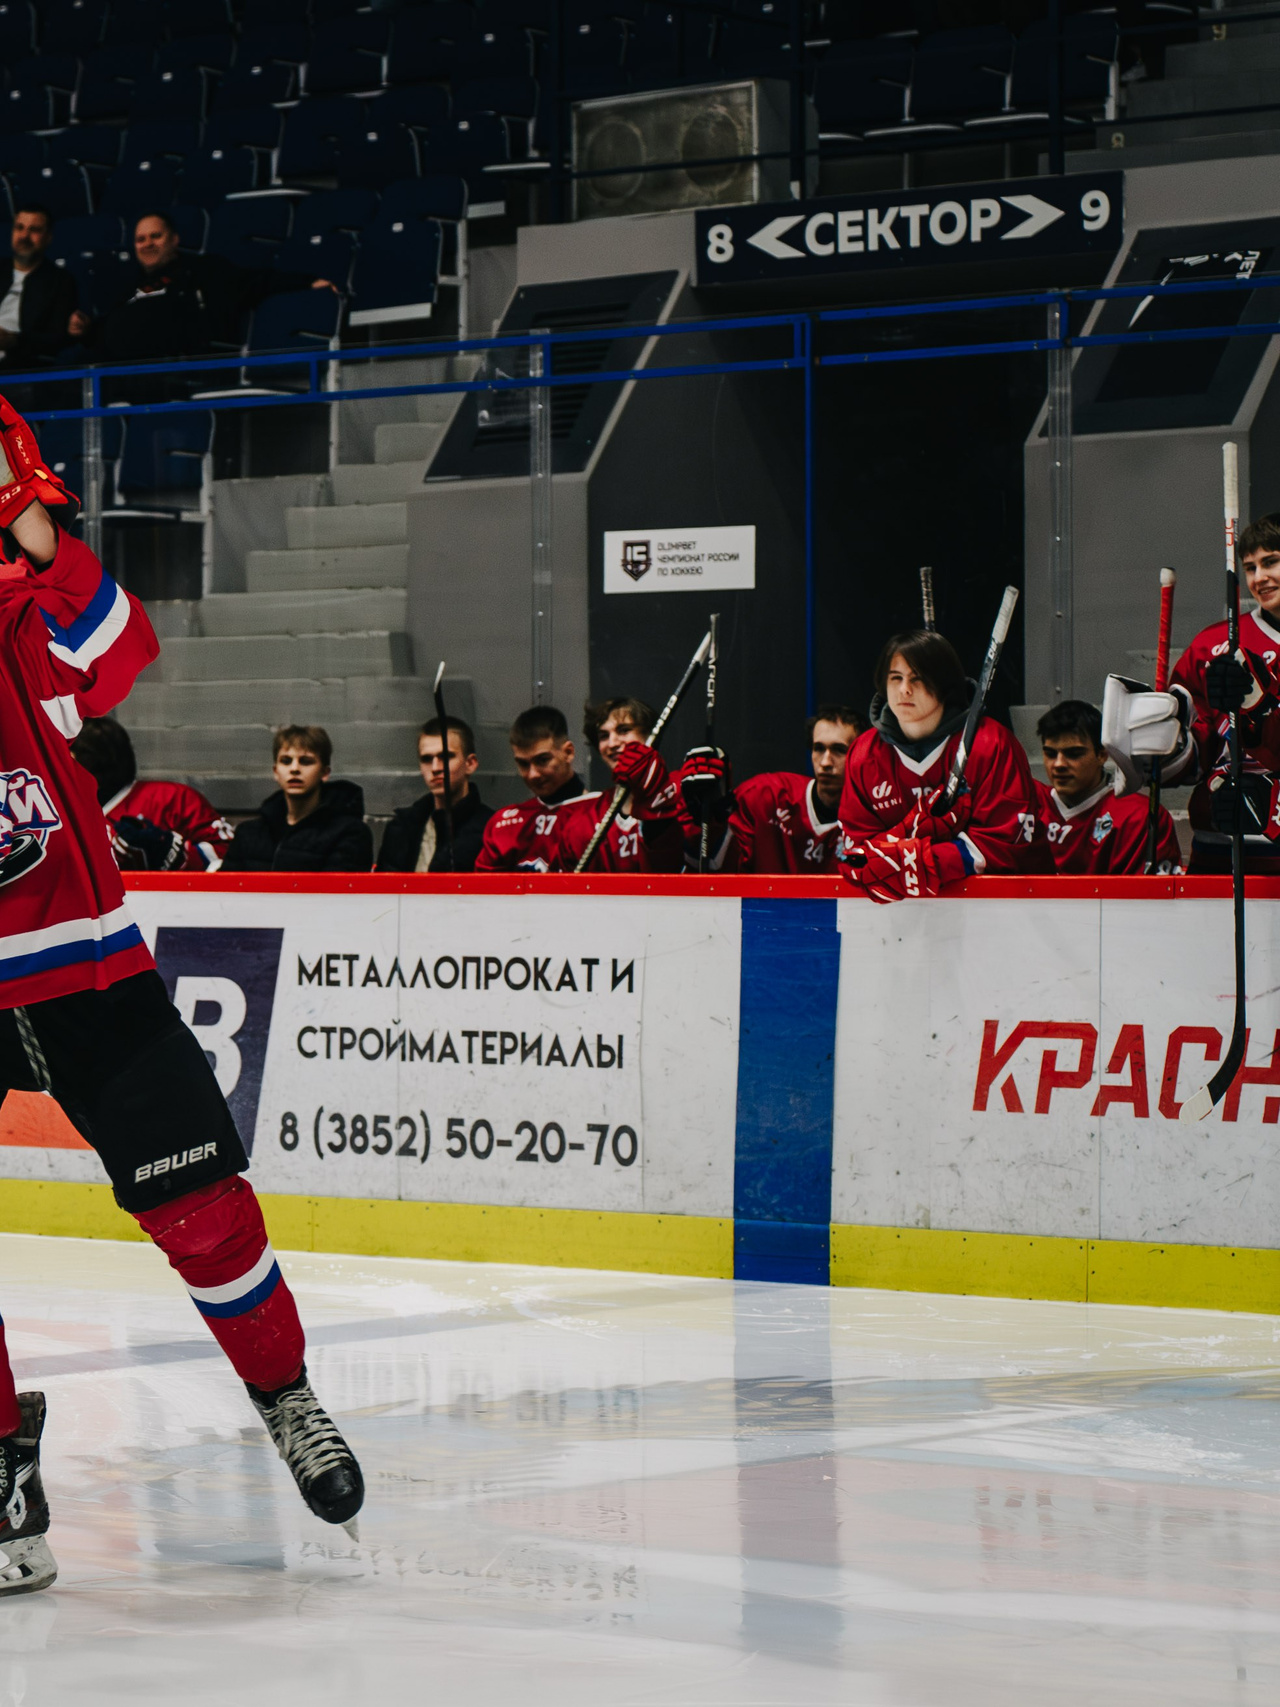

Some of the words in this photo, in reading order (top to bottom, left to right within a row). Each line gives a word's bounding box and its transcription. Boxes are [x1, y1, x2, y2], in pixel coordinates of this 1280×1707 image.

[707, 223, 734, 263] 8
[804, 198, 1002, 257] СЕКТОР
[1080, 189, 1111, 232] 9
[657, 553, 705, 563] ЧЕМПИОНАТ
[707, 552, 740, 562] РОССИИ
[657, 567, 668, 576] ПО
[535, 814, 557, 836] 97
[1047, 821, 1073, 844] 81
[618, 832, 638, 858] 27
[803, 838, 824, 864] 24
[296, 953, 598, 993] МЕТАЛЛОПРОКАТ
[611, 957, 635, 994] И
[296, 1018, 624, 1070] СТРОЙМАТЕРИАЛЫ
[279, 1111, 299, 1152] 8
[314, 1106, 432, 1165] (3852)
[444, 1117, 638, 1167] 50-20-70
[134, 1141, 219, 1184] BAUER
